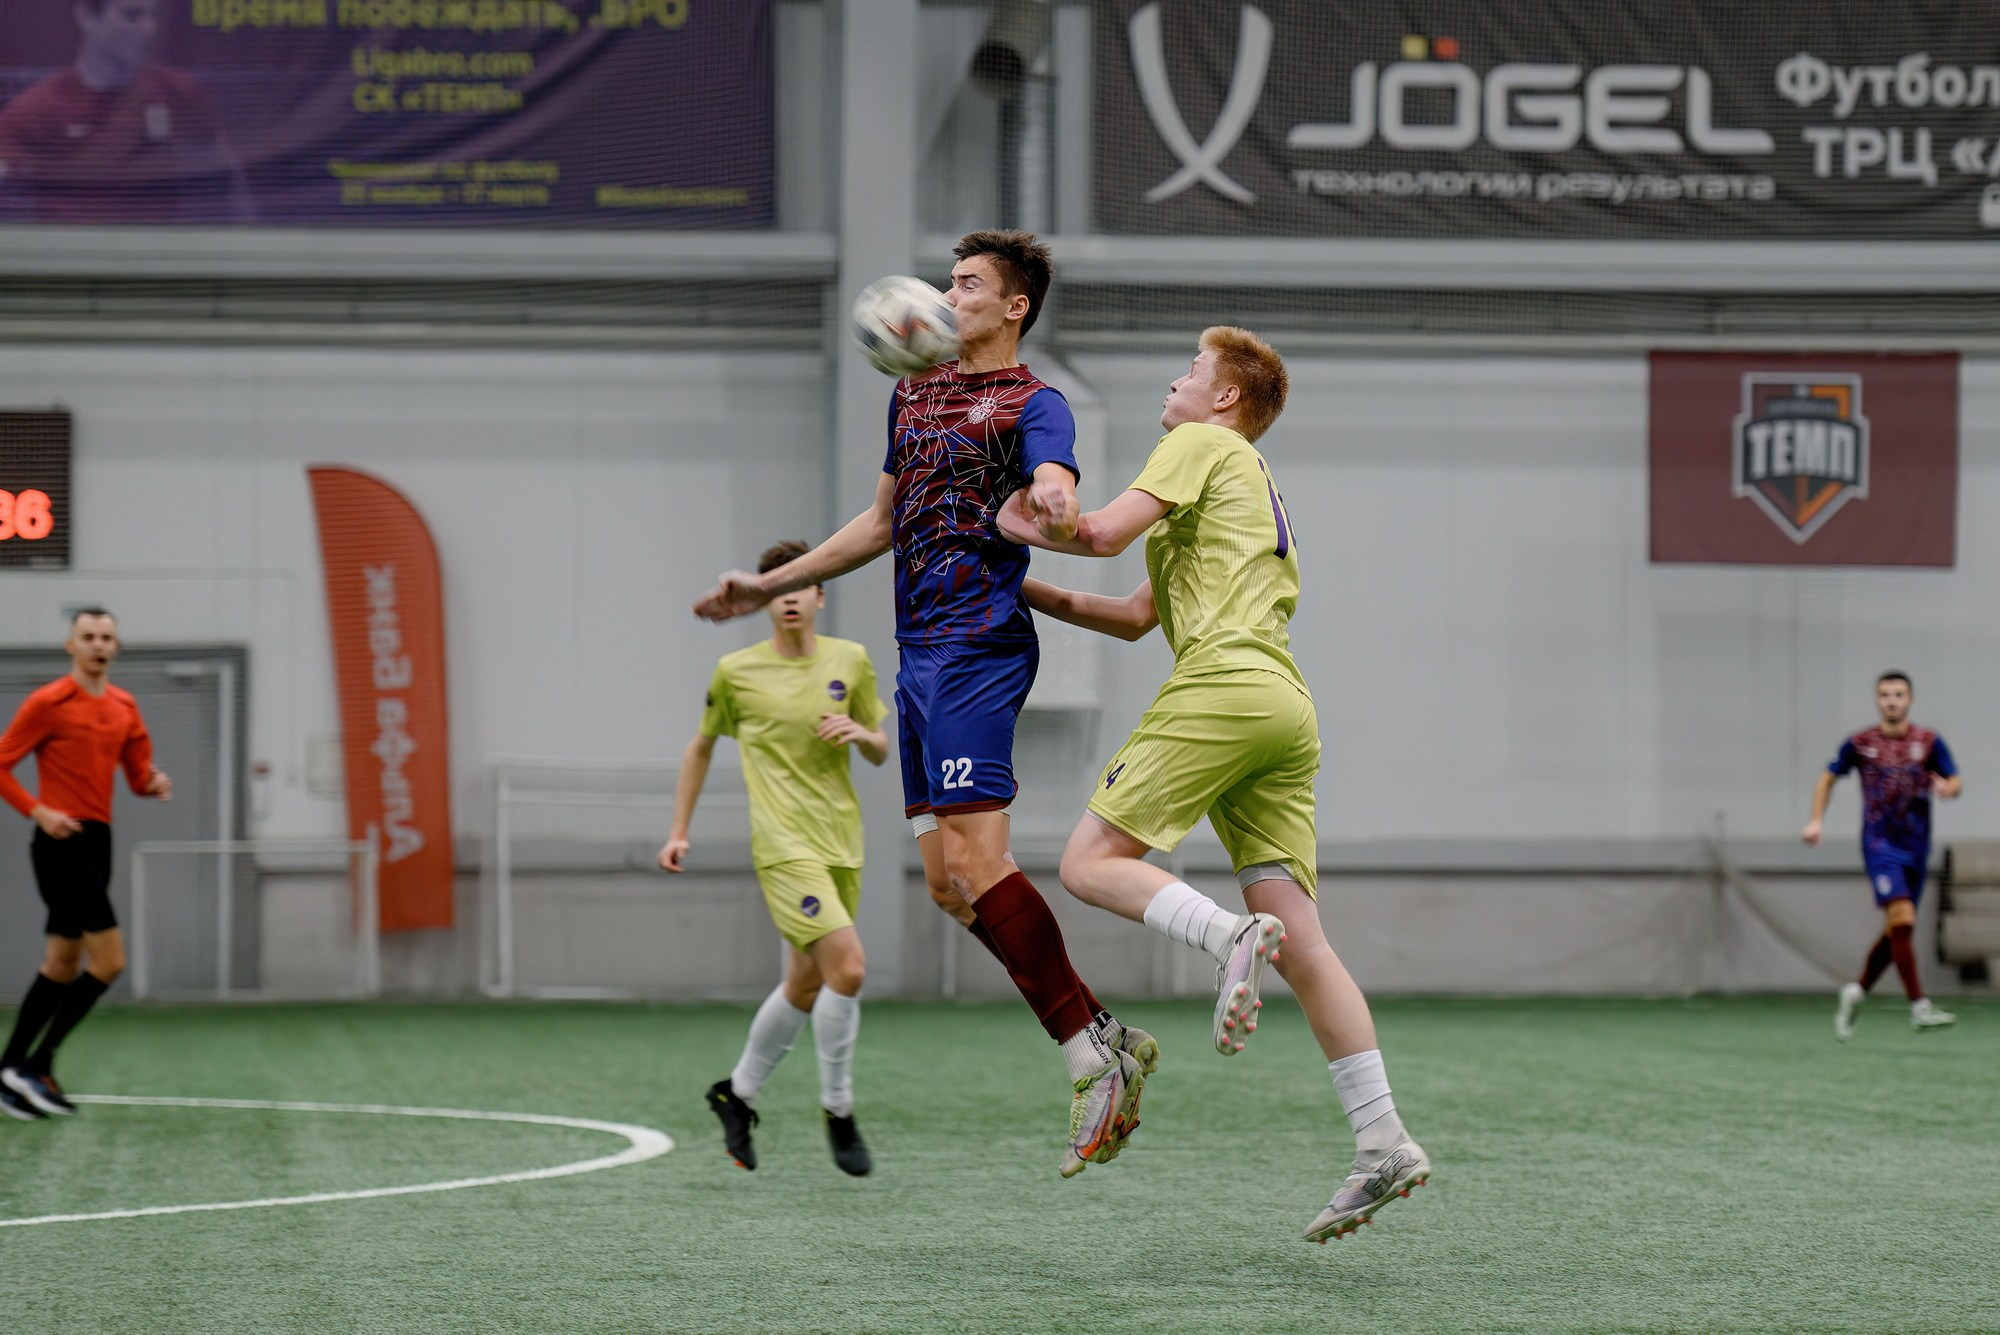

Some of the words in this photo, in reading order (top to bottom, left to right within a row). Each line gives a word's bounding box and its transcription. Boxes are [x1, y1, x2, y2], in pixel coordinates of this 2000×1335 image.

[1775, 51, 2000, 120] Футбол
[1537, 172, 1776, 203] результата
[1801, 126, 1939, 188] ТРЦ
[1747, 418, 1857, 481] ТЕМП
[941, 757, 974, 790] 22
